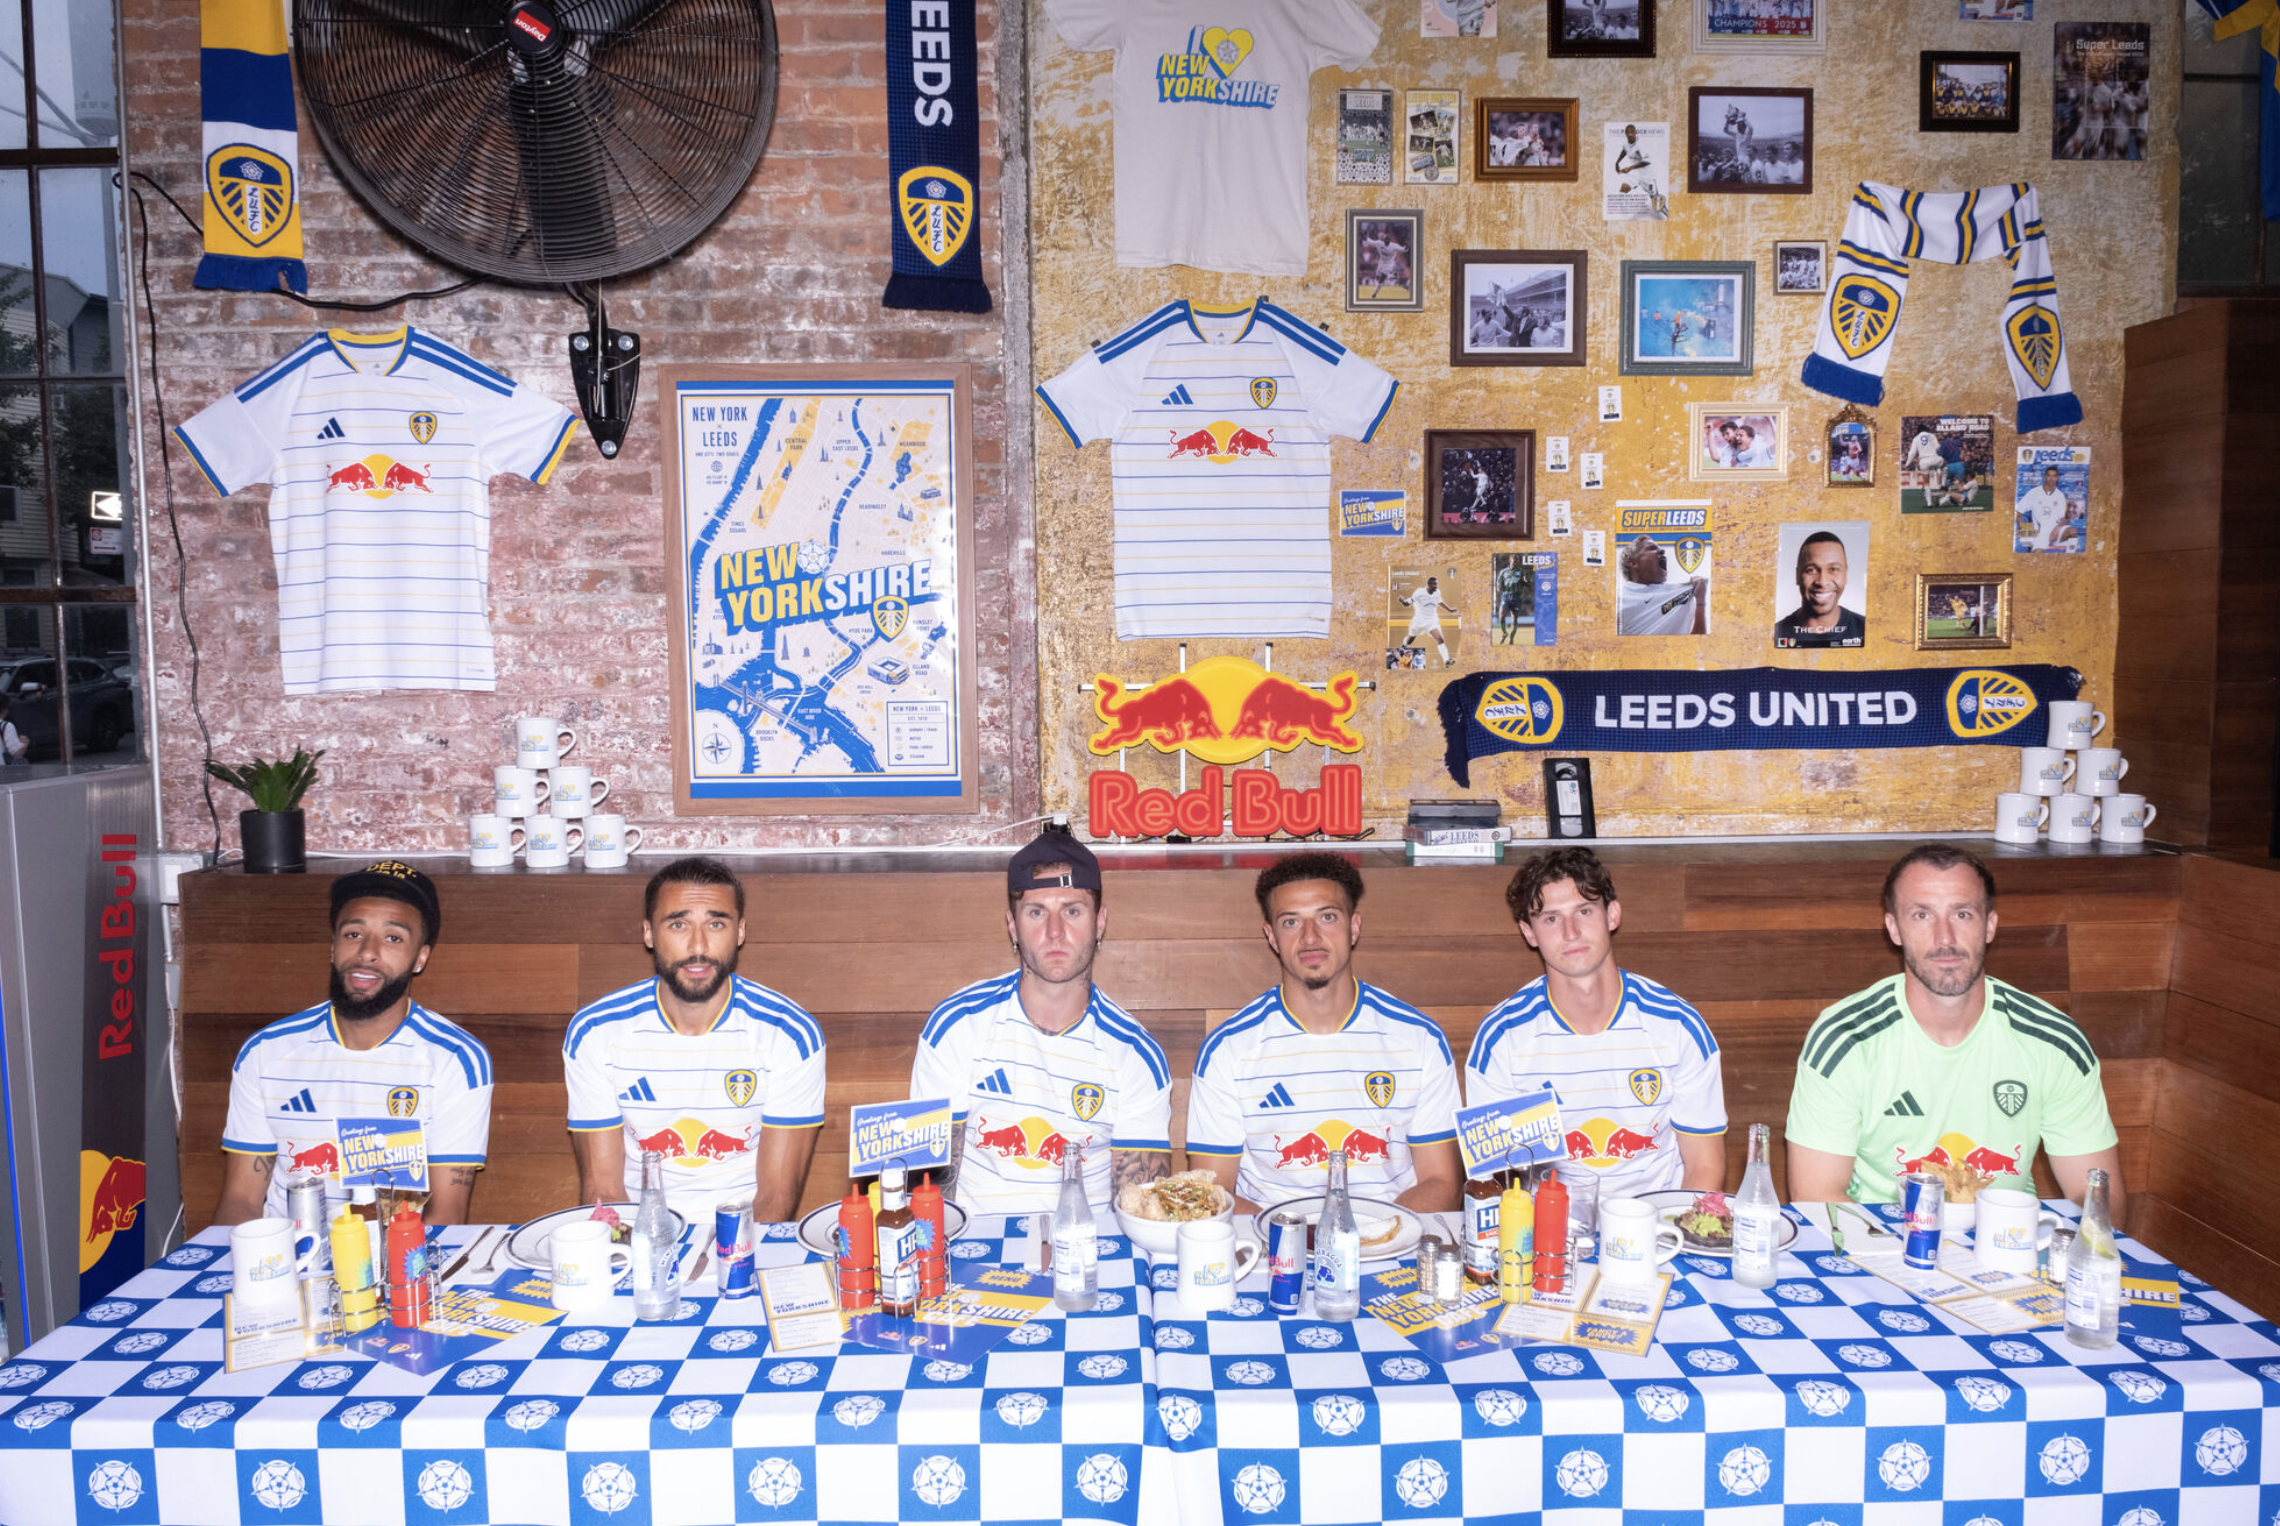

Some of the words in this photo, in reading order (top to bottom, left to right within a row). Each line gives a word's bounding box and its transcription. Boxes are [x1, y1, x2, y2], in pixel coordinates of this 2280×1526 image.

[515, 18, 547, 42] Dayton
[1714, 18, 1768, 29] CHAMPIONS
[1774, 20, 1797, 29] 2025
[2076, 38, 2109, 52] Super
[2111, 39, 2145, 51] Leeds
[1160, 53, 1210, 75] NEW
[1162, 76, 1280, 106] YORKSHIRE
[692, 406, 716, 422] NEW
[721, 406, 748, 422] YORK
[1936, 424, 1967, 432] ELLAND
[1969, 424, 1990, 432] ROAD
[702, 431, 738, 447] LEEDS
[1920, 435, 1929, 446] 9
[1345, 502, 1368, 515] NEW
[1346, 507, 1404, 526] YORKSHIRE
[720, 542, 800, 590] NEW
[1522, 555, 1551, 565] LEEDS
[726, 559, 932, 627] YORKSHIRE
[1595, 694, 1735, 729] LEEDS
[1750, 690, 1917, 726] UNITED
[1089, 765, 1224, 838] Red
[1232, 764, 1363, 837] Bull
[1450, 831, 1480, 840] LEEDS
[101, 833, 137, 939] Bull
[100, 948, 134, 1060] Red
[858, 1120, 895, 1144] NEW
[861, 1121, 949, 1159] YORKSHIRE
[1466, 1118, 1499, 1145] NEW
[1471, 1113, 1559, 1159] YORKSHIRE
[344, 1134, 376, 1154] NEW
[347, 1144, 423, 1171] YORKSHIRE
[1912, 1213, 1933, 1225] Bull
[733, 1240, 752, 1253] Bull
[1275, 1256, 1294, 1268] Bull
[988, 1275, 1022, 1283] MENU
[1387, 1271, 1415, 1283] MENU
[773, 1302, 794, 1311] NEW
[776, 1299, 830, 1314] YORKSHIRE
[1368, 1292, 1401, 1307] THE
[1374, 1296, 1422, 1318] NEW
